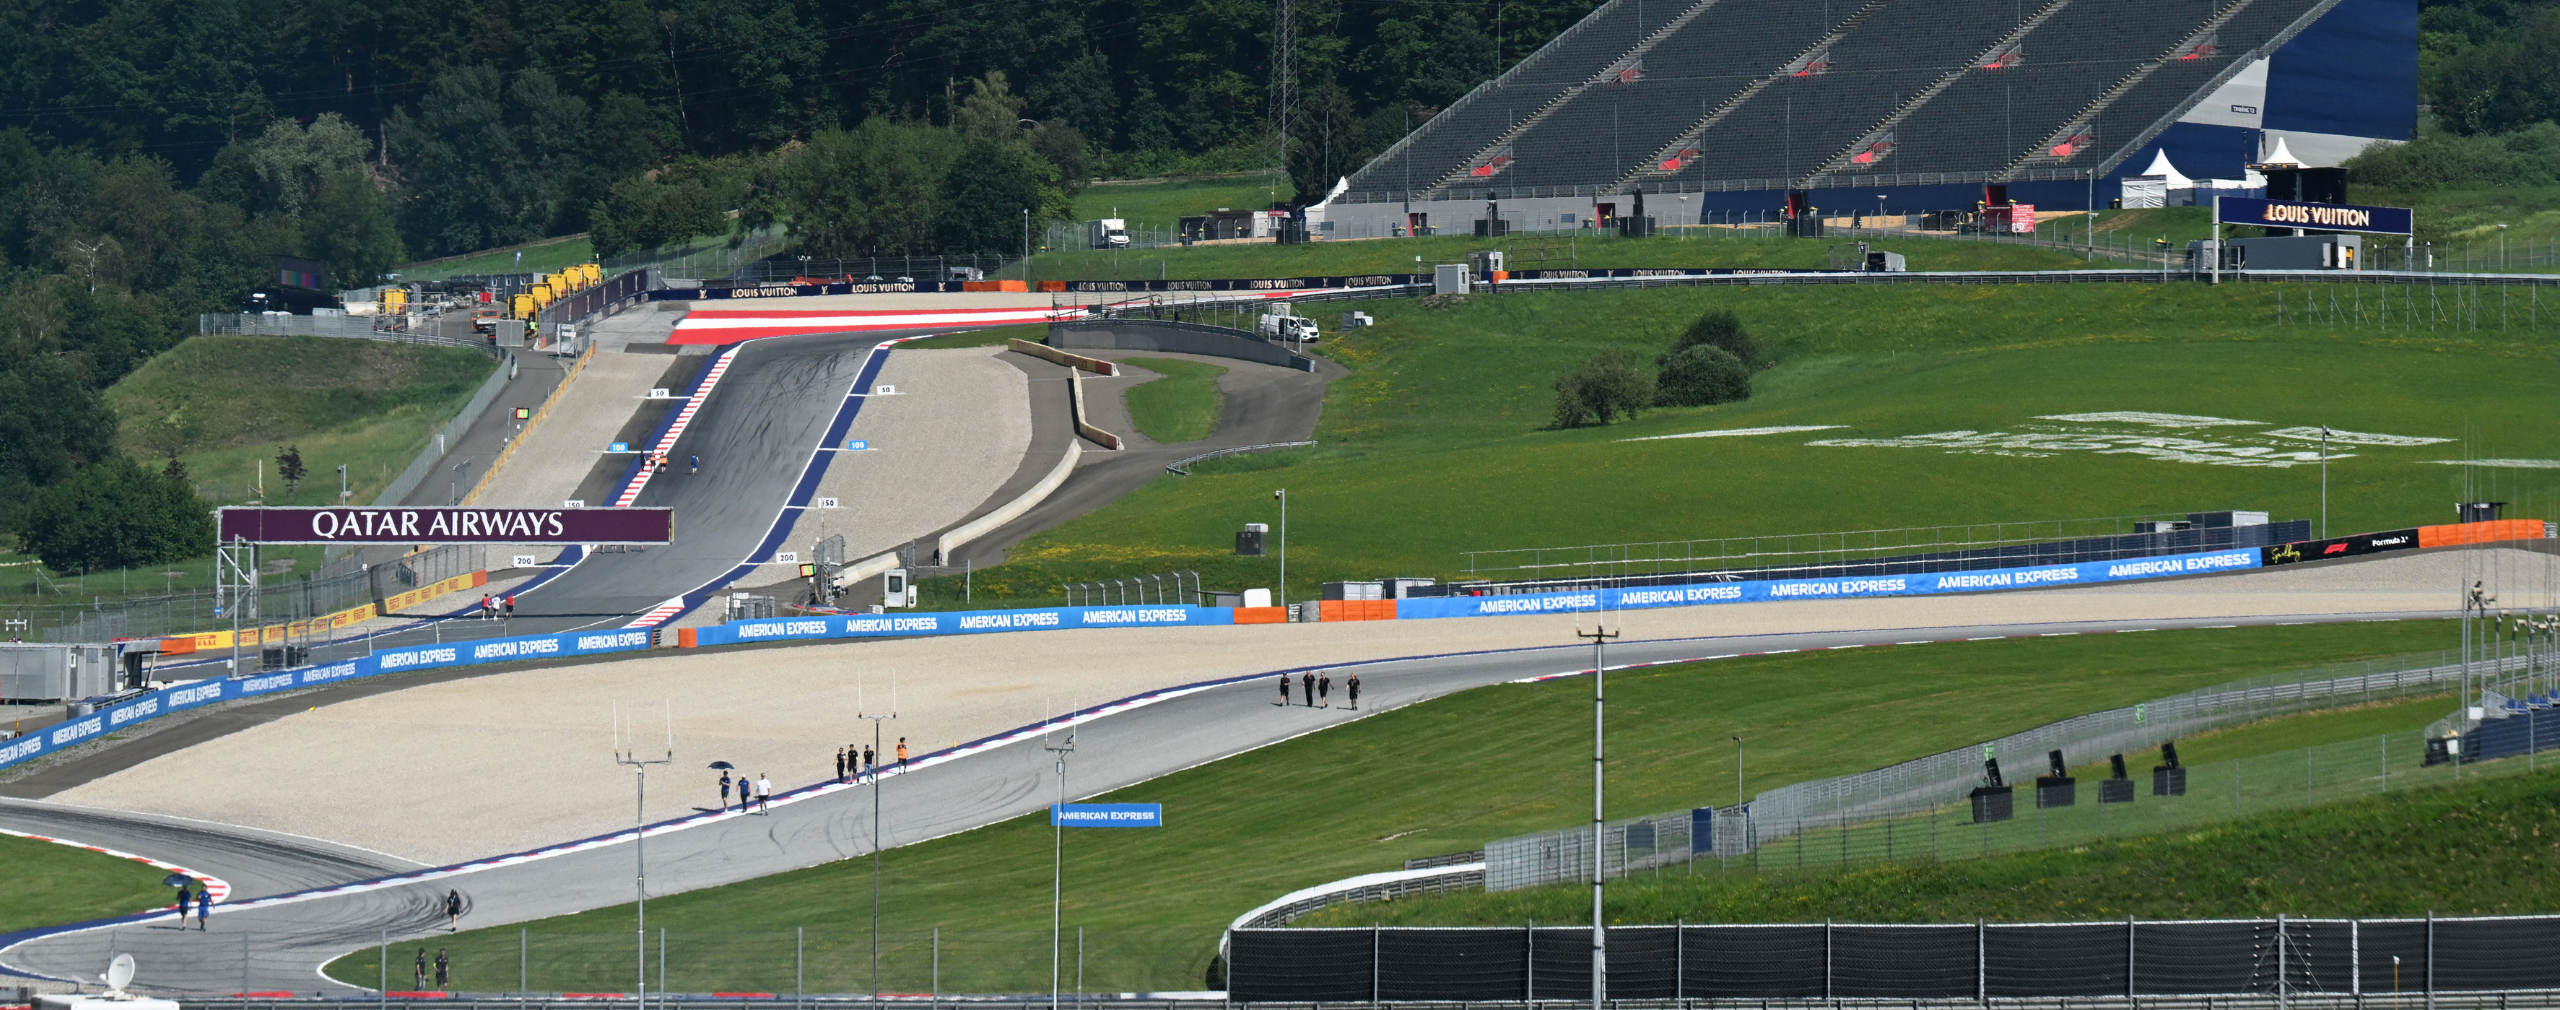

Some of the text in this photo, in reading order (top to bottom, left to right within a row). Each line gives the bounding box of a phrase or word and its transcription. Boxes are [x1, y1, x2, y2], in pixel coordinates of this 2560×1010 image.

[2267, 204, 2370, 227] LOUIS VUITTON
[731, 287, 797, 298] LOUIS VUITTON
[852, 282, 915, 293] LOUIS VUITTON
[1250, 278, 1305, 288] LOUIS VUITTON
[312, 511, 564, 539] QATAR AIRWAYS
[2372, 537, 2400, 547] Formula
[2108, 553, 2251, 577] AMERICAN EXPRESS
[1771, 579, 1906, 597] AMERICAN EXPRESS
[1938, 568, 2078, 589] AMERICAN EXPRESS
[1480, 594, 1596, 613] AMERICAN EXPRESS
[1621, 586, 1742, 605] AMERICAN EXPRESS
[846, 618, 937, 632] AMERICAN EXPRESS
[960, 612, 1059, 629] AMERICAN EXPRESS
[1082, 609, 1187, 624] AMERICAN EXPRESS
[739, 621, 827, 638] AMERICAN EXPRESS
[474, 639, 558, 658] AMERICAN EXPRESS
[578, 634, 618, 650] AMERICAN
[381, 648, 456, 668] AMERICAN EXPRESS
[303, 663, 355, 682] AMERICAN EXPRESS
[242, 674, 293, 692] AMERICAN EXPRESS
[168, 682, 221, 707] AMERICAN EXPRESS
[110, 698, 158, 726] AMERICAN EXPRESS
[52, 716, 101, 746] AMERICAN EXPRESS
[0, 736, 41, 764] ERICAN EXPRESS
[1059, 812, 1155, 820] AMERICAN EXPRESS
